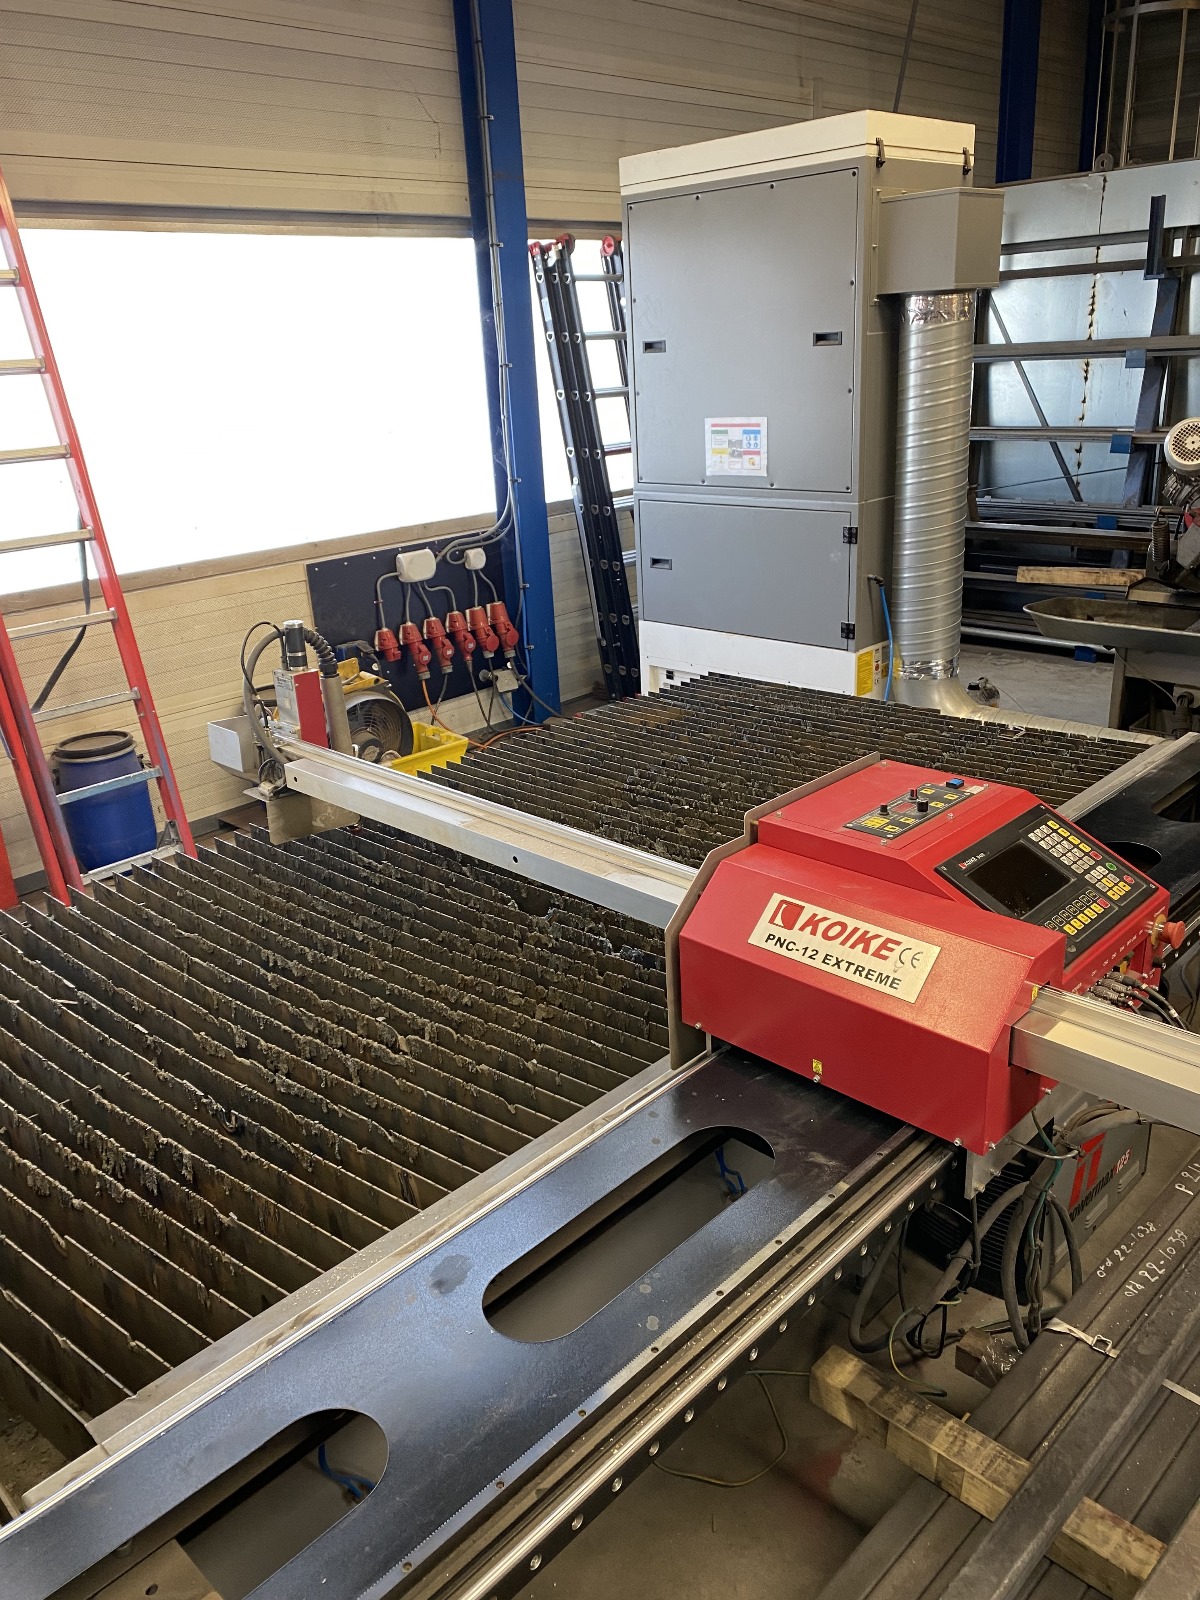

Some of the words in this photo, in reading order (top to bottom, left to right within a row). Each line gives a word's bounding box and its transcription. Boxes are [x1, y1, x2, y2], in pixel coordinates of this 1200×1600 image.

[798, 912, 903, 961] KOIKE
[764, 933, 819, 961] PNC-12
[821, 953, 903, 990] EXTREME
[1115, 1149, 1131, 1174] 125
